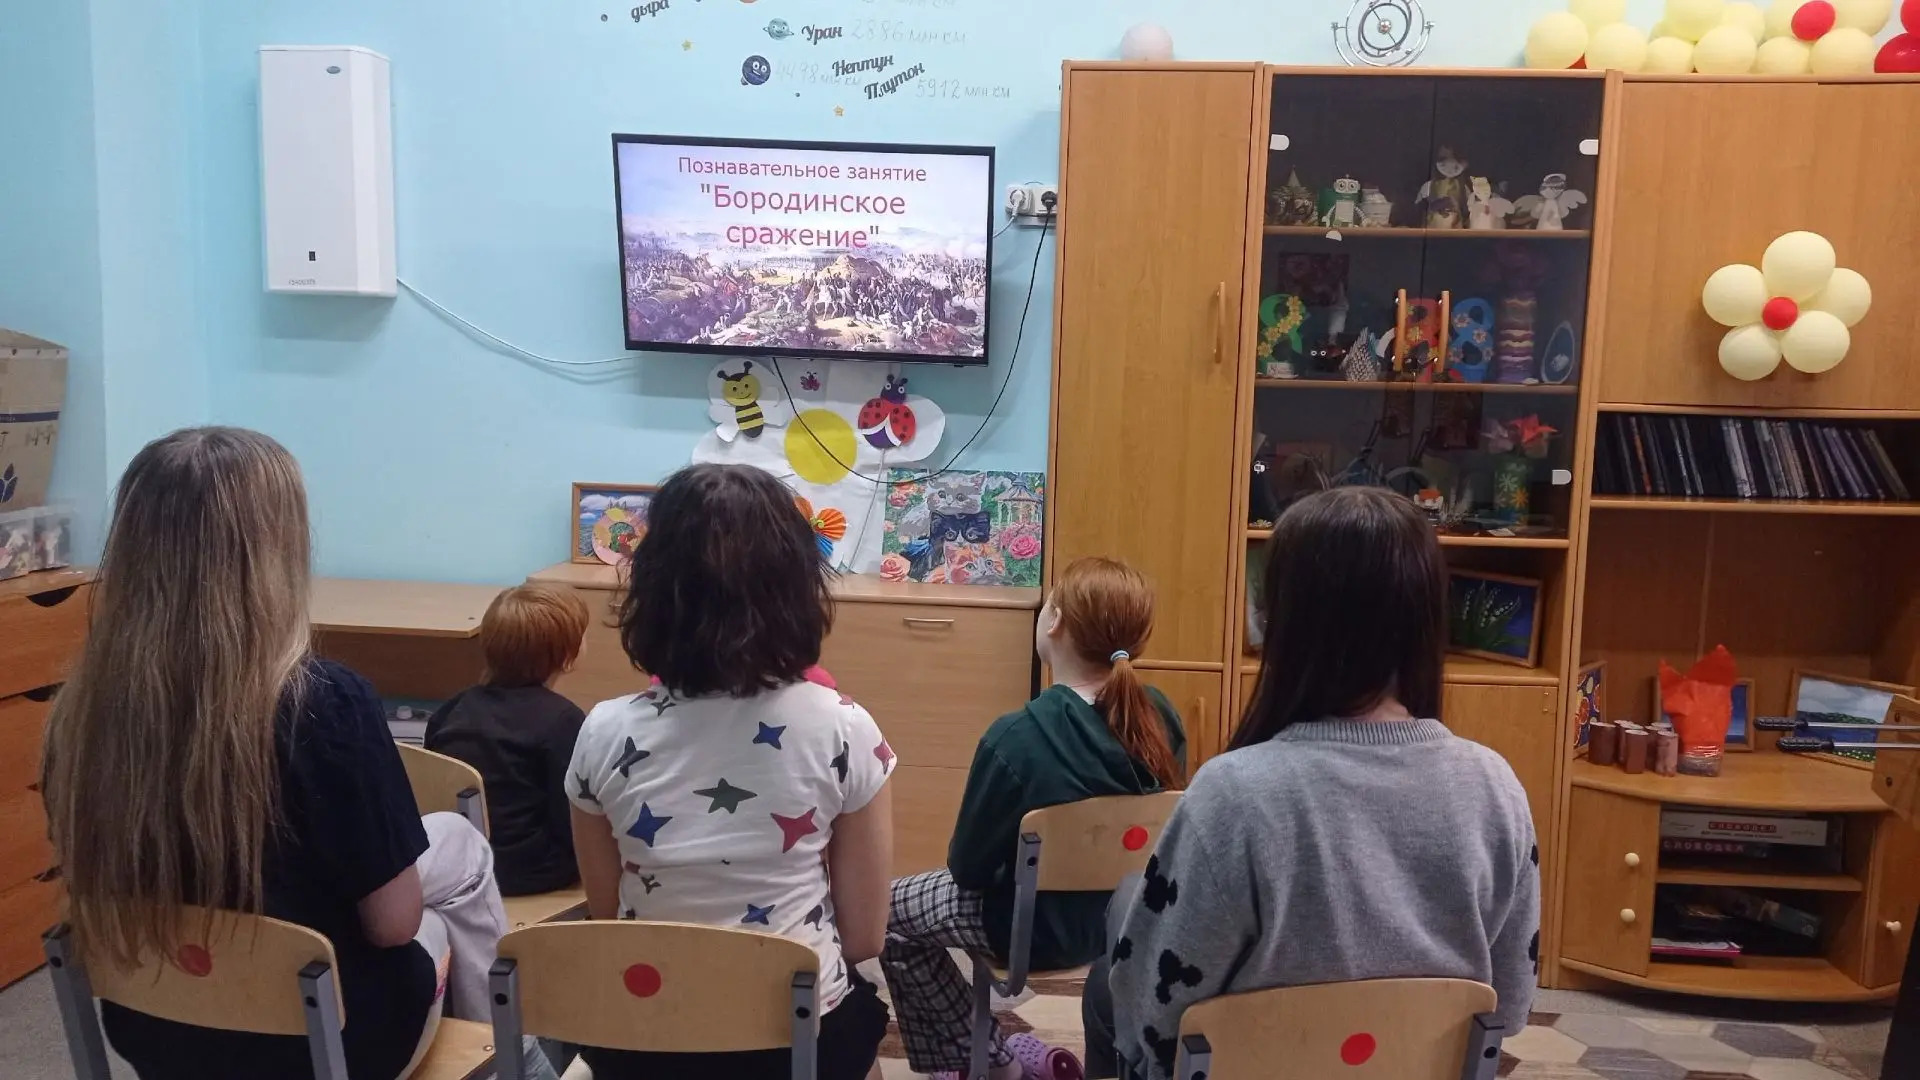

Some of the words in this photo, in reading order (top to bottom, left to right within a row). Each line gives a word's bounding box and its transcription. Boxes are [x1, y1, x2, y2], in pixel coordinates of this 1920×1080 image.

[631, 0, 669, 22] дыра
[801, 24, 843, 45] Уран
[832, 55, 894, 77] Нептун
[864, 62, 926, 100] Плутон
[915, 78, 960, 99] 5912
[678, 156, 840, 179] Познавательное
[847, 165, 927, 182] занятие
[700, 183, 906, 215] "Бородинское
[726, 224, 880, 249] сражение"
